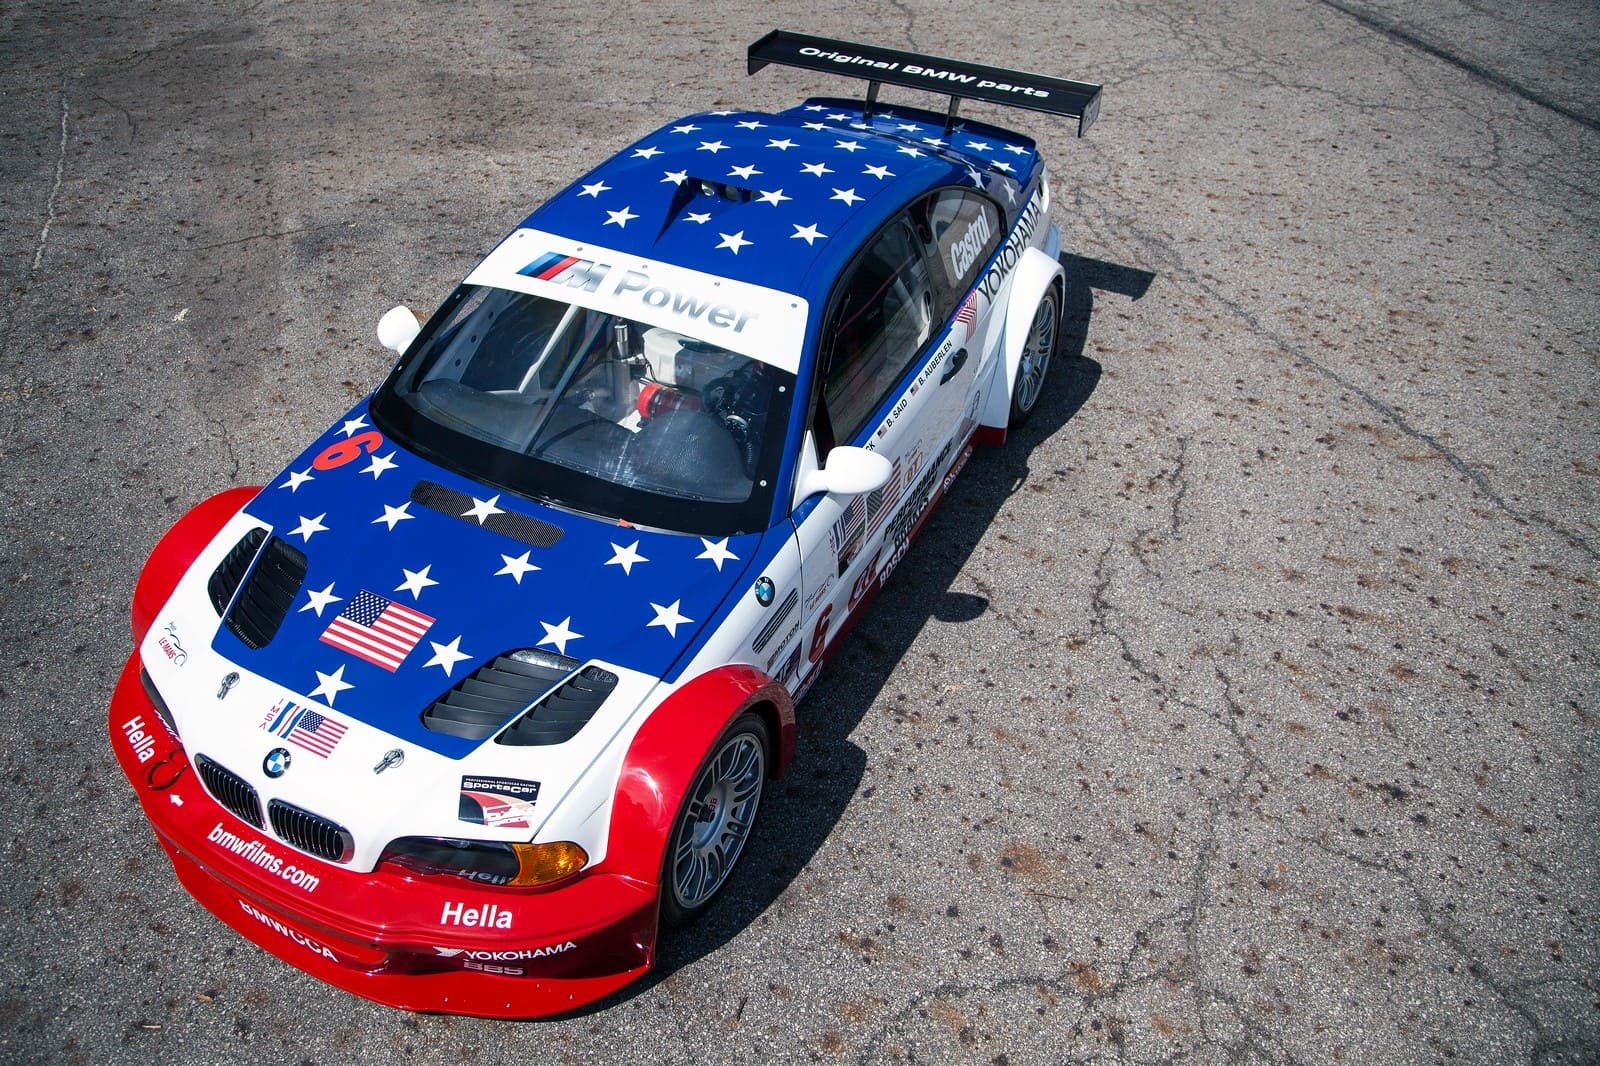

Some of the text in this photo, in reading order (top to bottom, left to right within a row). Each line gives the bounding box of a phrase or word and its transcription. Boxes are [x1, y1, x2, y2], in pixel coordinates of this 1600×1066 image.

[799, 47, 1050, 98] Original BMW parts
[951, 205, 990, 280] Castrol
[978, 201, 1041, 305] YOKOHAMA
[613, 270, 759, 333] Power
[925, 340, 953, 377] AUBERLEN
[886, 399, 908, 427] B. SAID
[313, 431, 383, 471] 6
[122, 715, 155, 763] Hella
[463, 781, 537, 793] SportsCar
[207, 822, 320, 893] bmwfilms.com
[459, 869, 513, 885] Hell
[440, 901, 513, 929] Hella
[463, 941, 577, 961] YOKOHAMA
[463, 961, 524, 975] BBS
